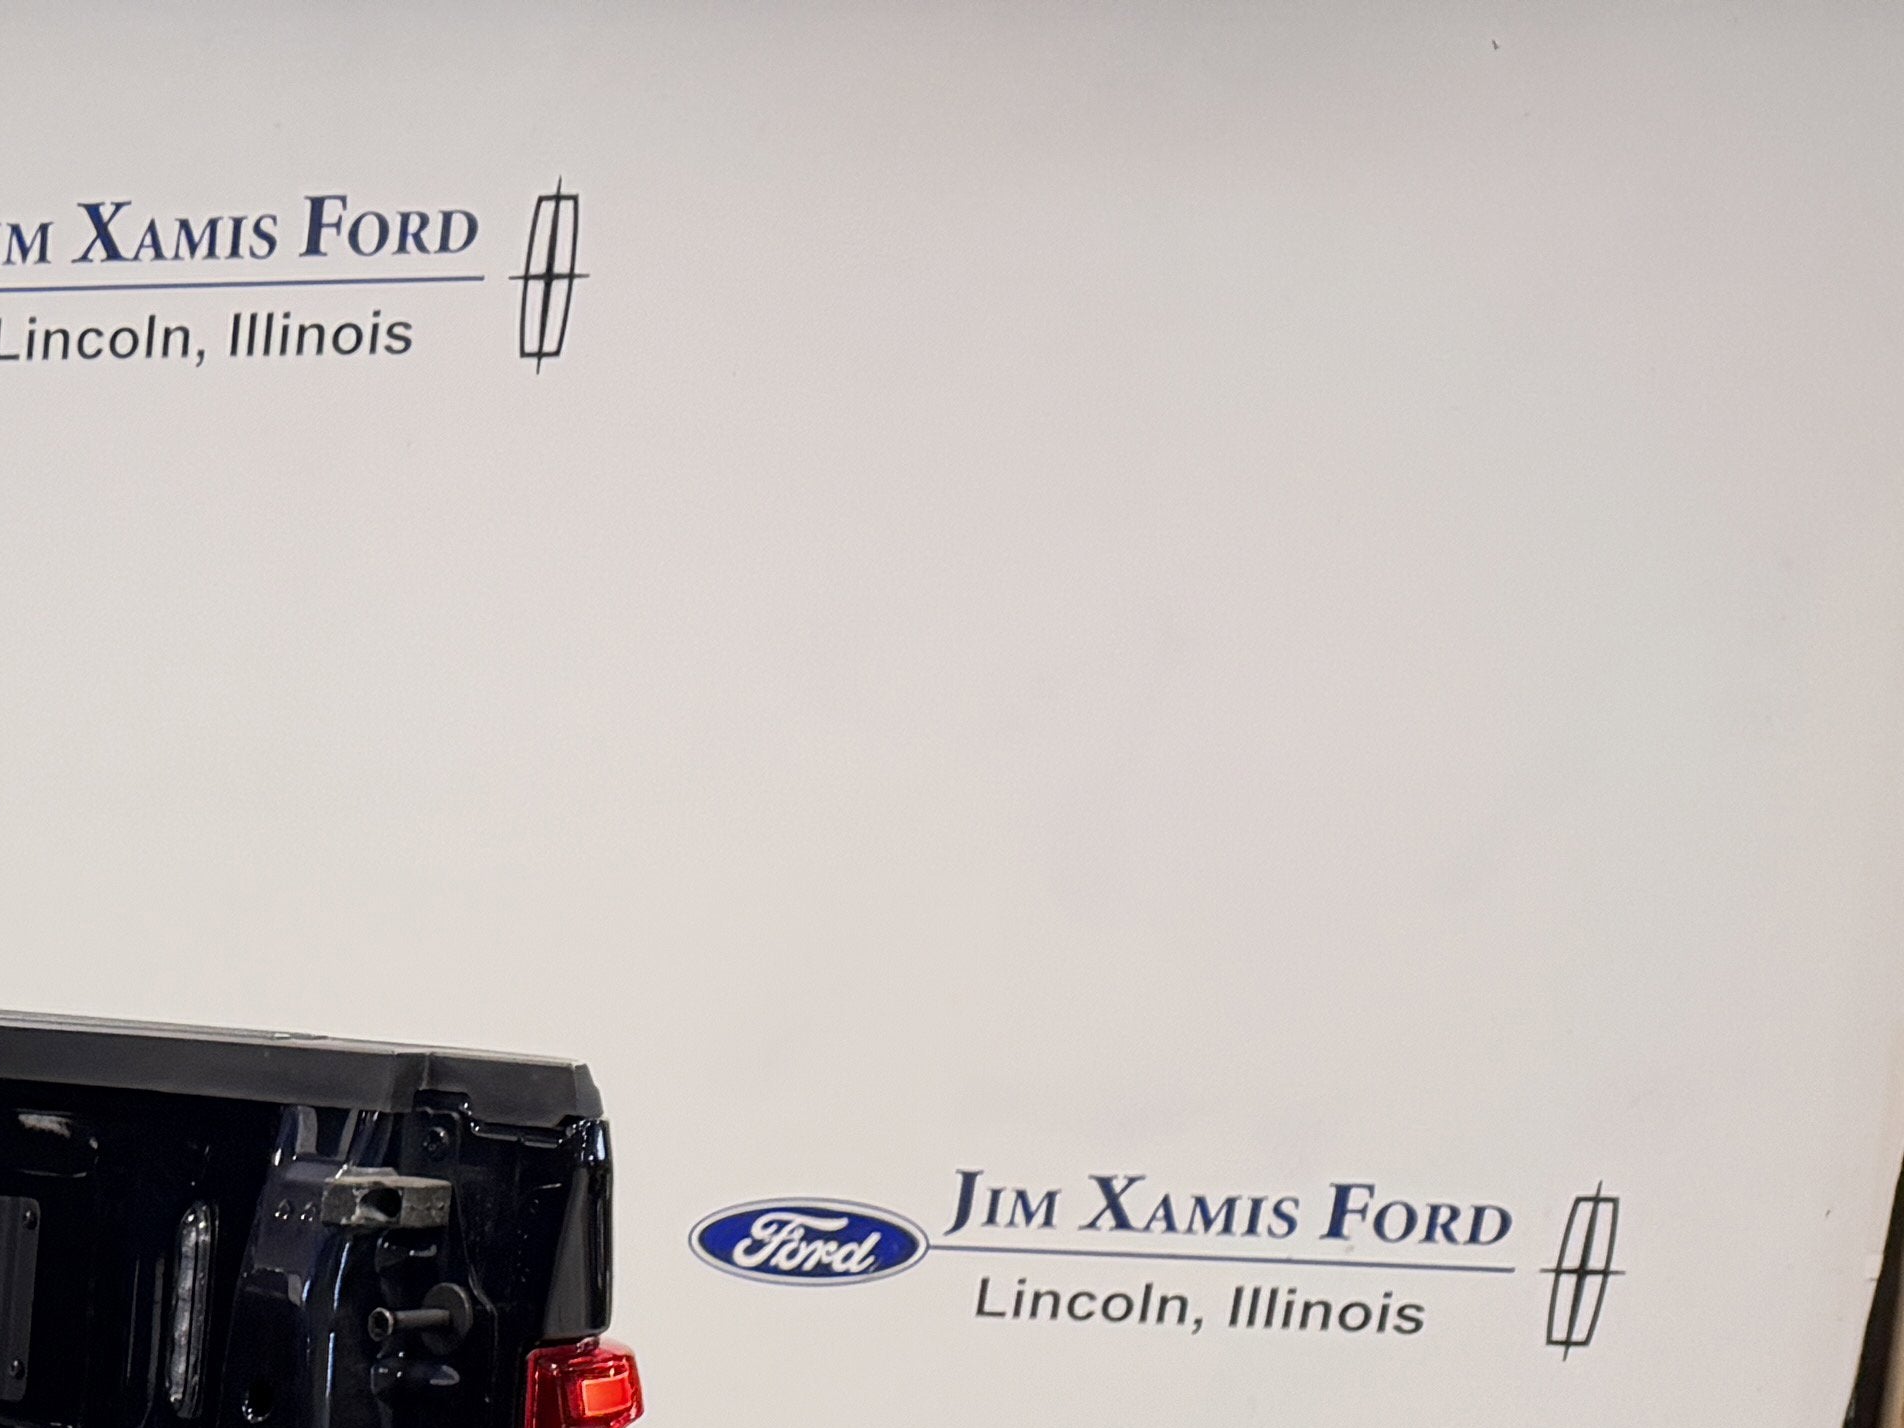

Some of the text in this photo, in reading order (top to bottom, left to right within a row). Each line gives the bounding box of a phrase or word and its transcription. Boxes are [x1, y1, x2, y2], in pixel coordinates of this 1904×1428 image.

[71, 200, 279, 263] XAMIS
[299, 194, 479, 257] FORD
[229, 310, 414, 357] Illinois
[942, 1168, 1513, 1246] JIM XAMIS FORD
[732, 1211, 882, 1274] Ford
[975, 1276, 1426, 1336] Lincoln, Illinois
